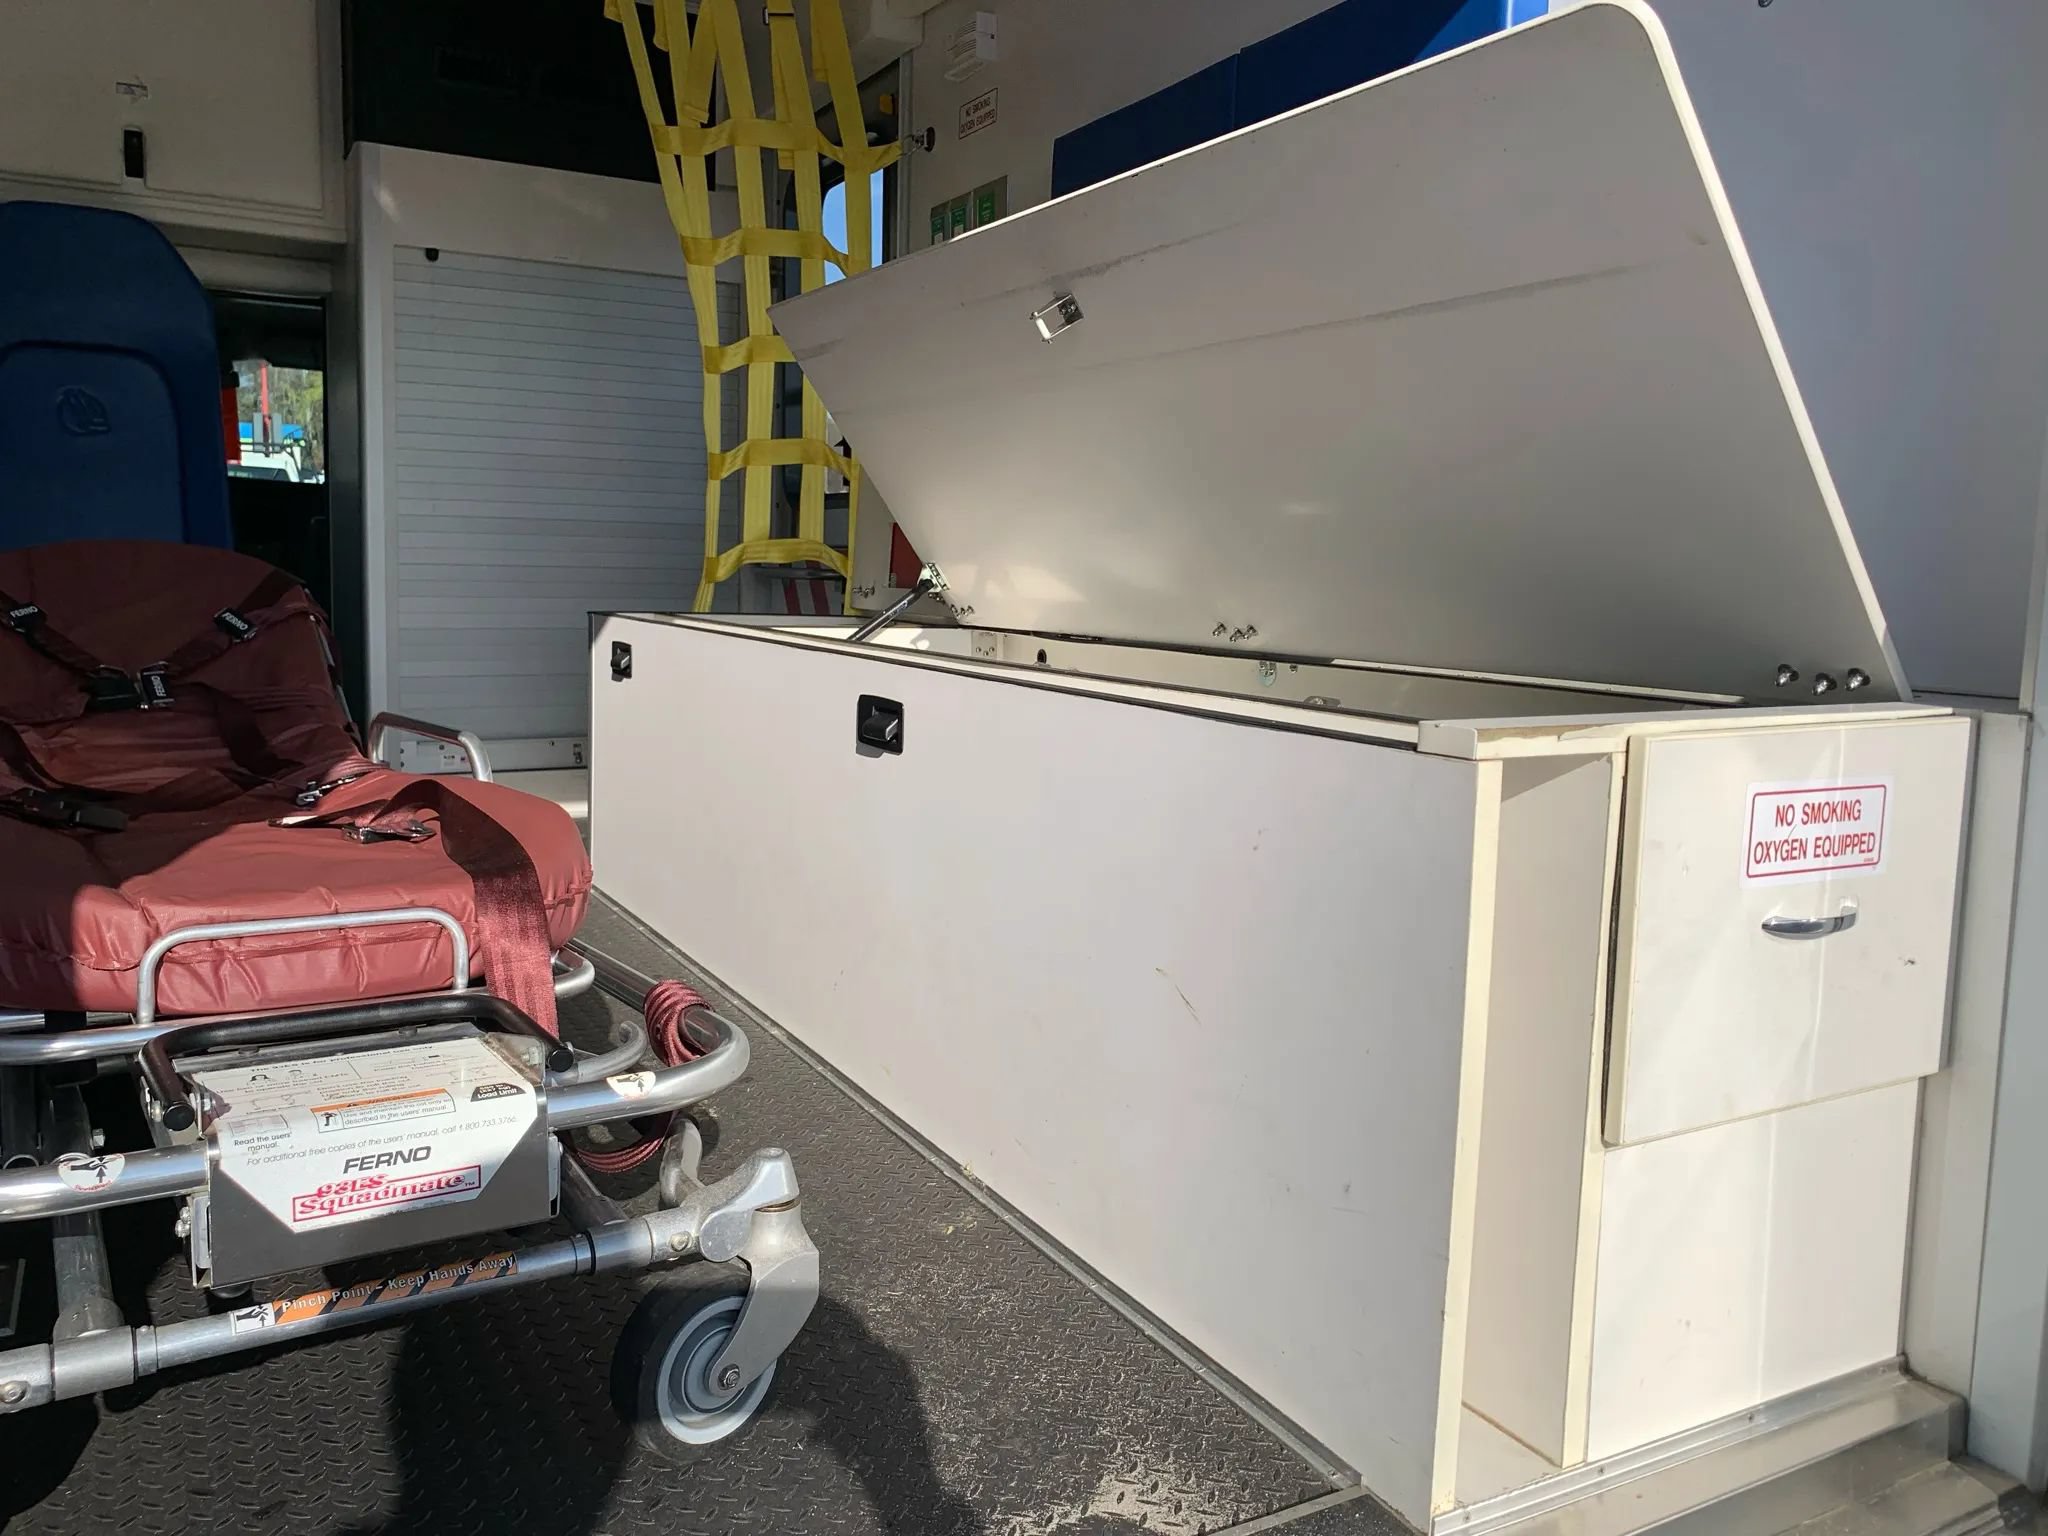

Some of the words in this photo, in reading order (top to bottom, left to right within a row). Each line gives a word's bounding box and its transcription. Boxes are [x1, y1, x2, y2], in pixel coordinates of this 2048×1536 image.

[10, 606, 38, 617] FERNO
[222, 612, 248, 630] FERNO
[152, 676, 166, 696] FERNO
[1775, 804, 1795, 827] NO
[1801, 799, 1862, 825] SMOKING
[1753, 838, 1808, 864] OXYGEN
[1813, 832, 1876, 858] EQUIPPED
[234, 1138, 254, 1146] Read
[247, 1158, 261, 1166] For
[263, 1149, 306, 1164] additional
[309, 1147, 326, 1156] free
[328, 1142, 356, 1154] copies
[358, 1139, 367, 1147] of
[369, 1138, 382, 1146] the
[442, 1124, 456, 1134] call
[343, 1145, 432, 1174] FERNO
[299, 1174, 465, 1215] Squadmate
[282, 1295, 326, 1312] Pinch
[332, 1285, 371, 1302] Point
[388, 1275, 424, 1290] Keep
[429, 1264, 474, 1281] Hands
[479, 1255, 514, 1272] Away
